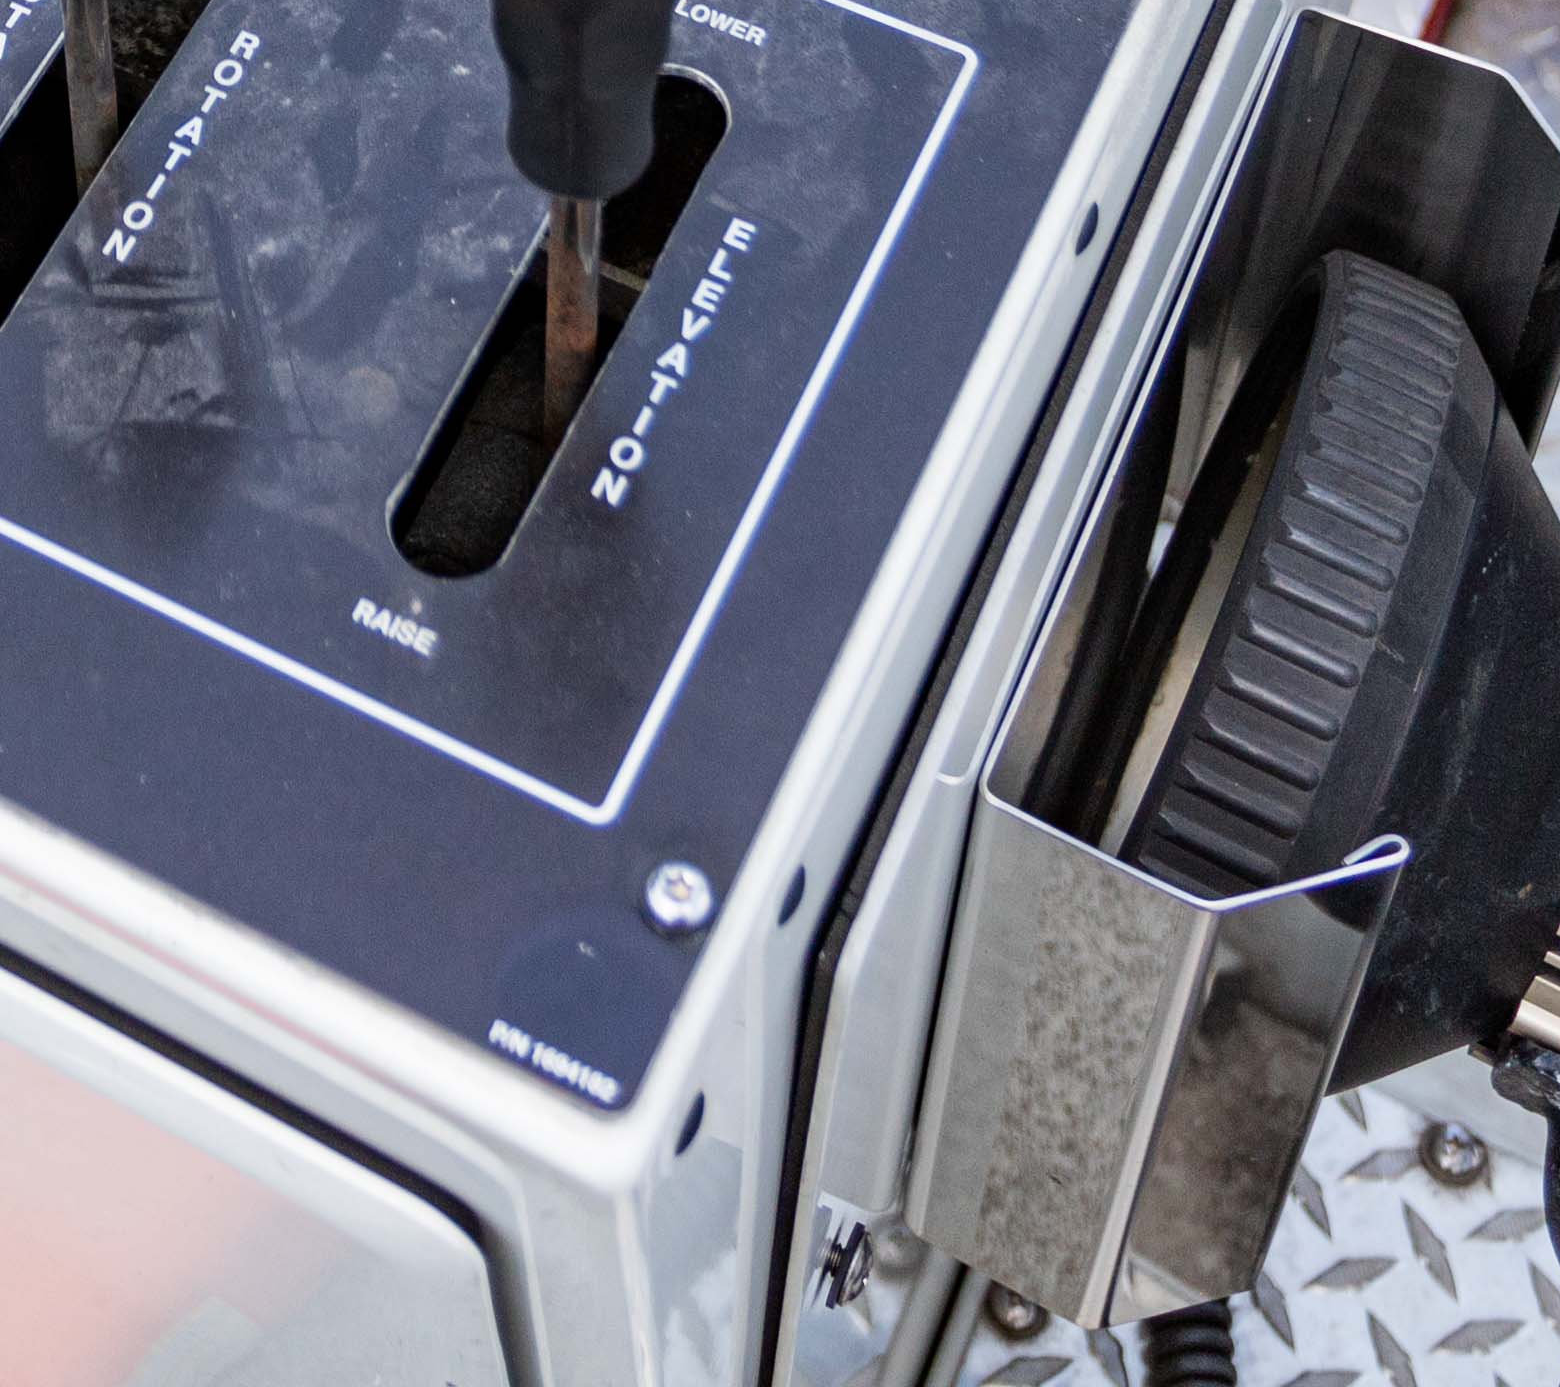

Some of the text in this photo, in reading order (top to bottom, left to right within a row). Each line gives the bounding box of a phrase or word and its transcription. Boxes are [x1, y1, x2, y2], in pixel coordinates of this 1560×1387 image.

[103, 31, 259, 260] ROTATION
[592, 219, 754, 503] ELEVATION
[352, 598, 436, 654] RAISE
